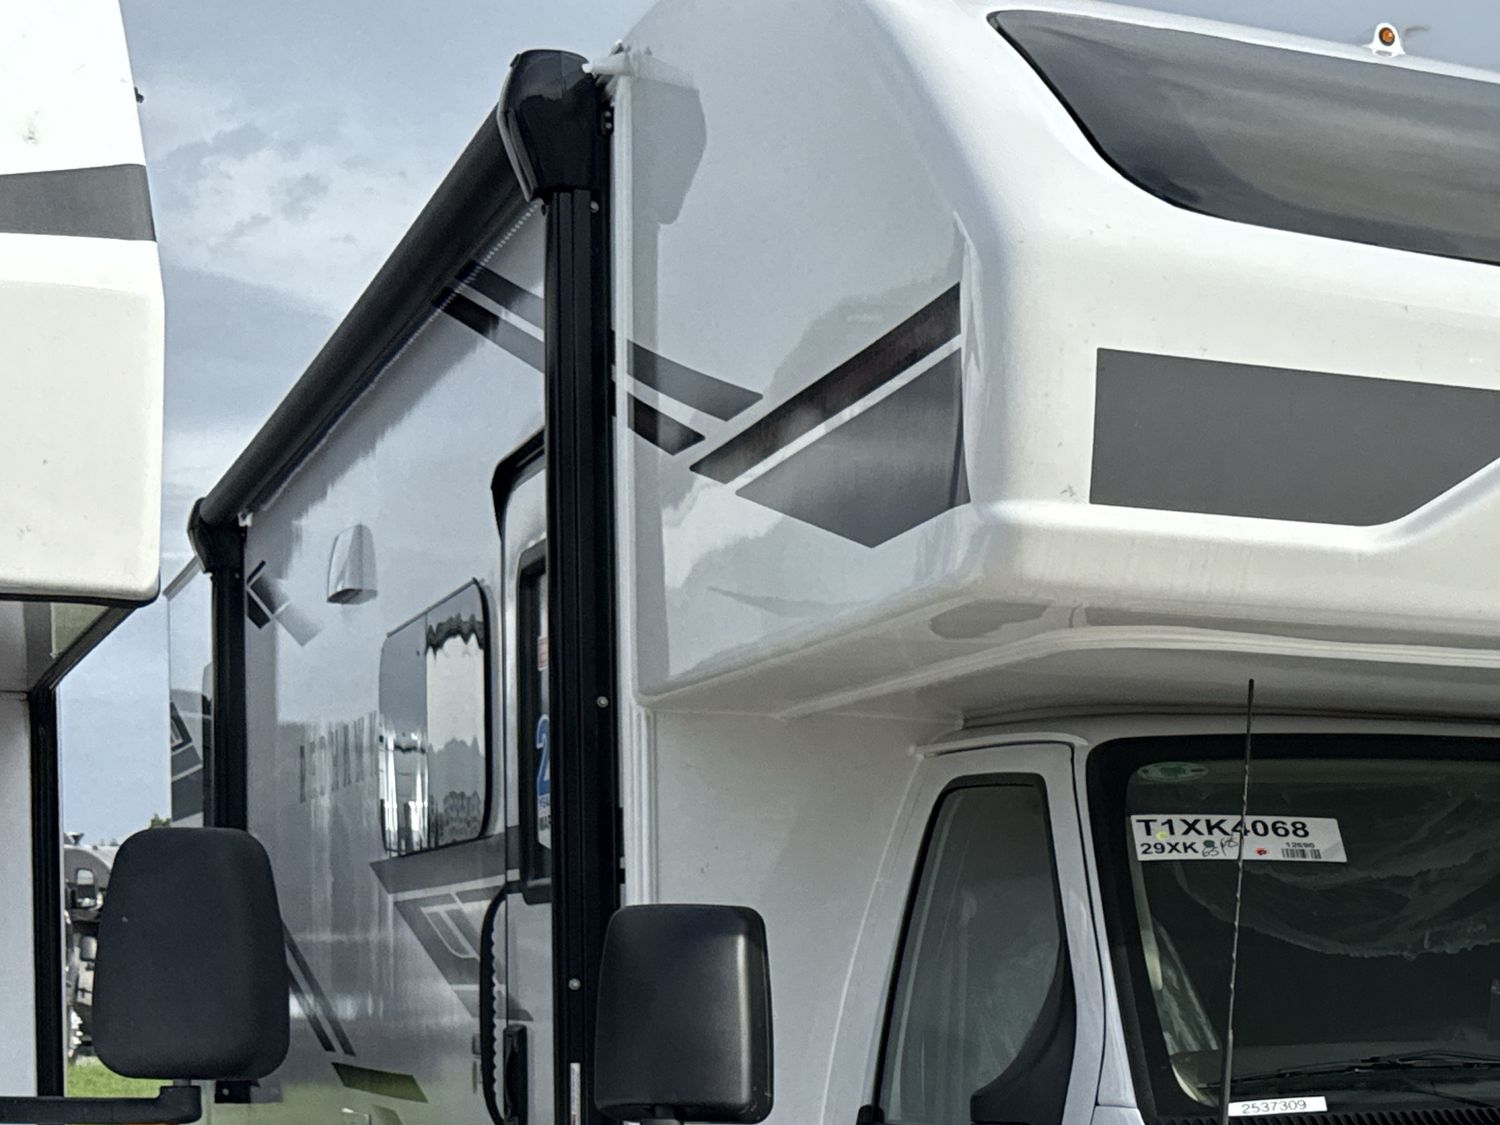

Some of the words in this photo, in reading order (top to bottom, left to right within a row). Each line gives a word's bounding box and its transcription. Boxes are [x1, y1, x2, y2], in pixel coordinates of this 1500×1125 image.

[1136, 818, 1310, 838] T1XK4068
[1139, 841, 1199, 855] 29XK
[1241, 1099, 1307, 1115] 2537309
